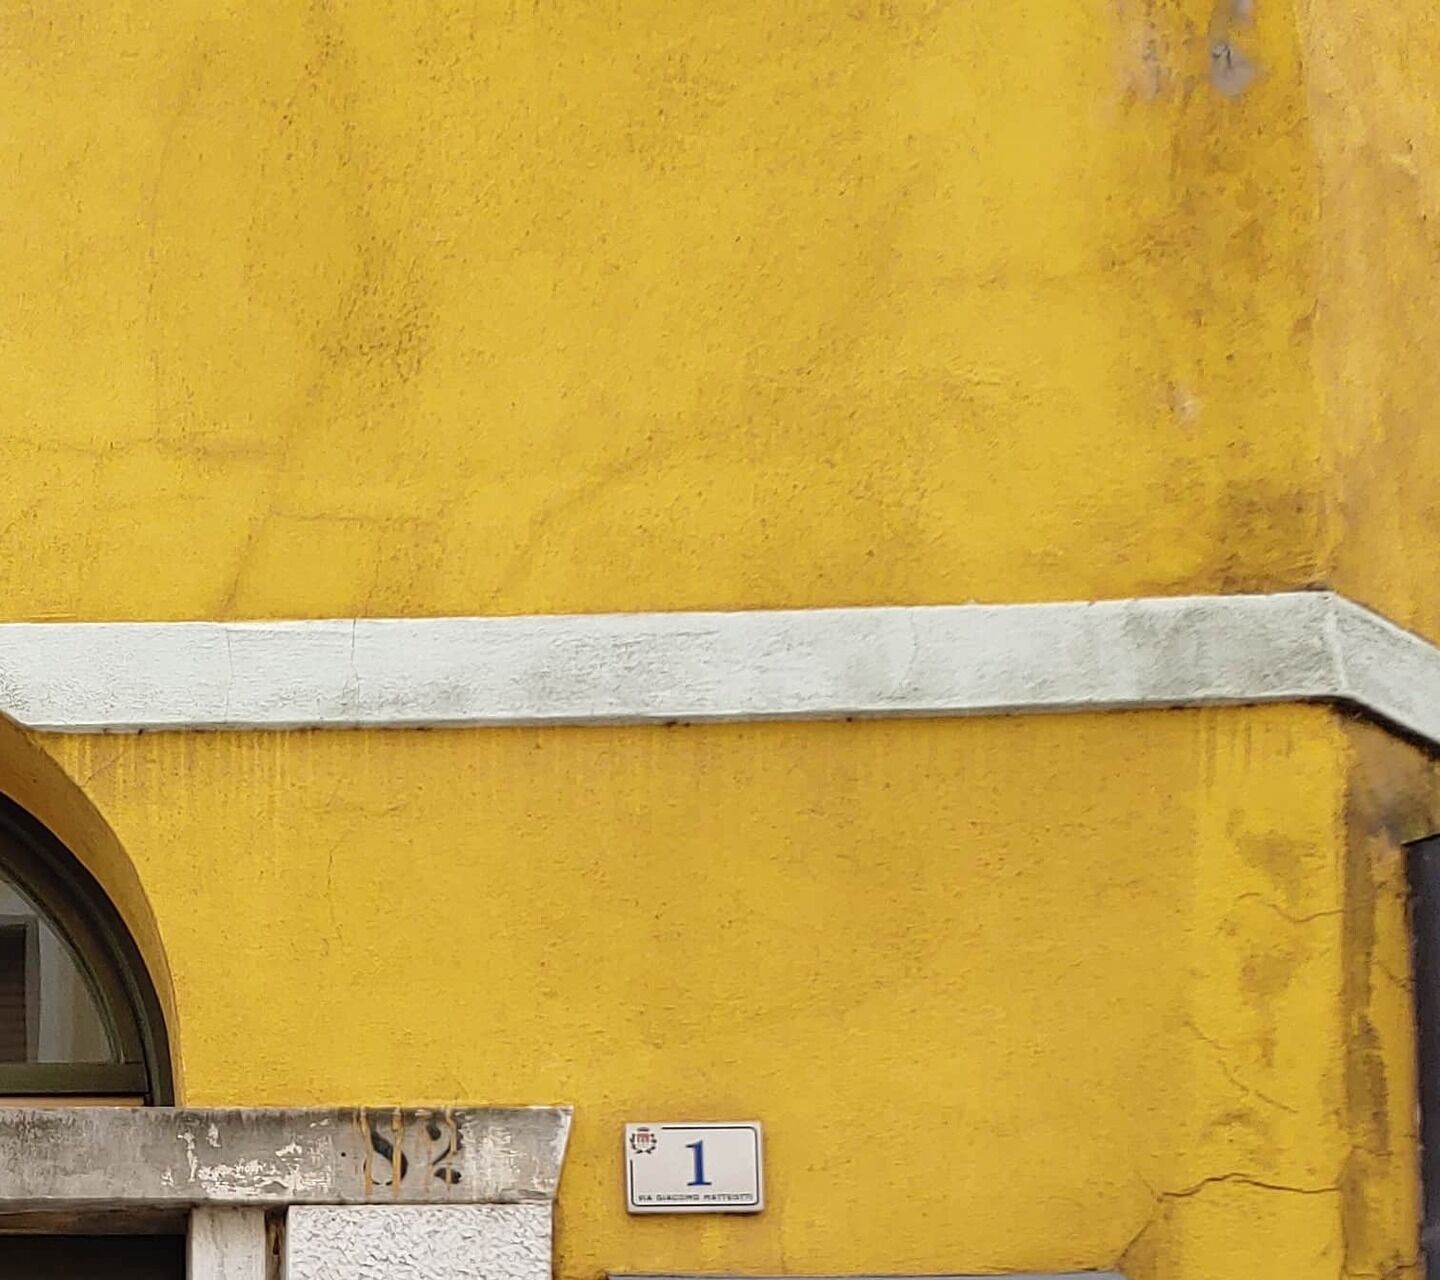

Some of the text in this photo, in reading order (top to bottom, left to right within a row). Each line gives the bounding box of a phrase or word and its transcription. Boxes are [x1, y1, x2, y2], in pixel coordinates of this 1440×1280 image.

[685, 1140, 712, 1186] 1
[656, 1193, 700, 1201] GIACOMO
[703, 1192, 753, 1201] MATTEOTTI
